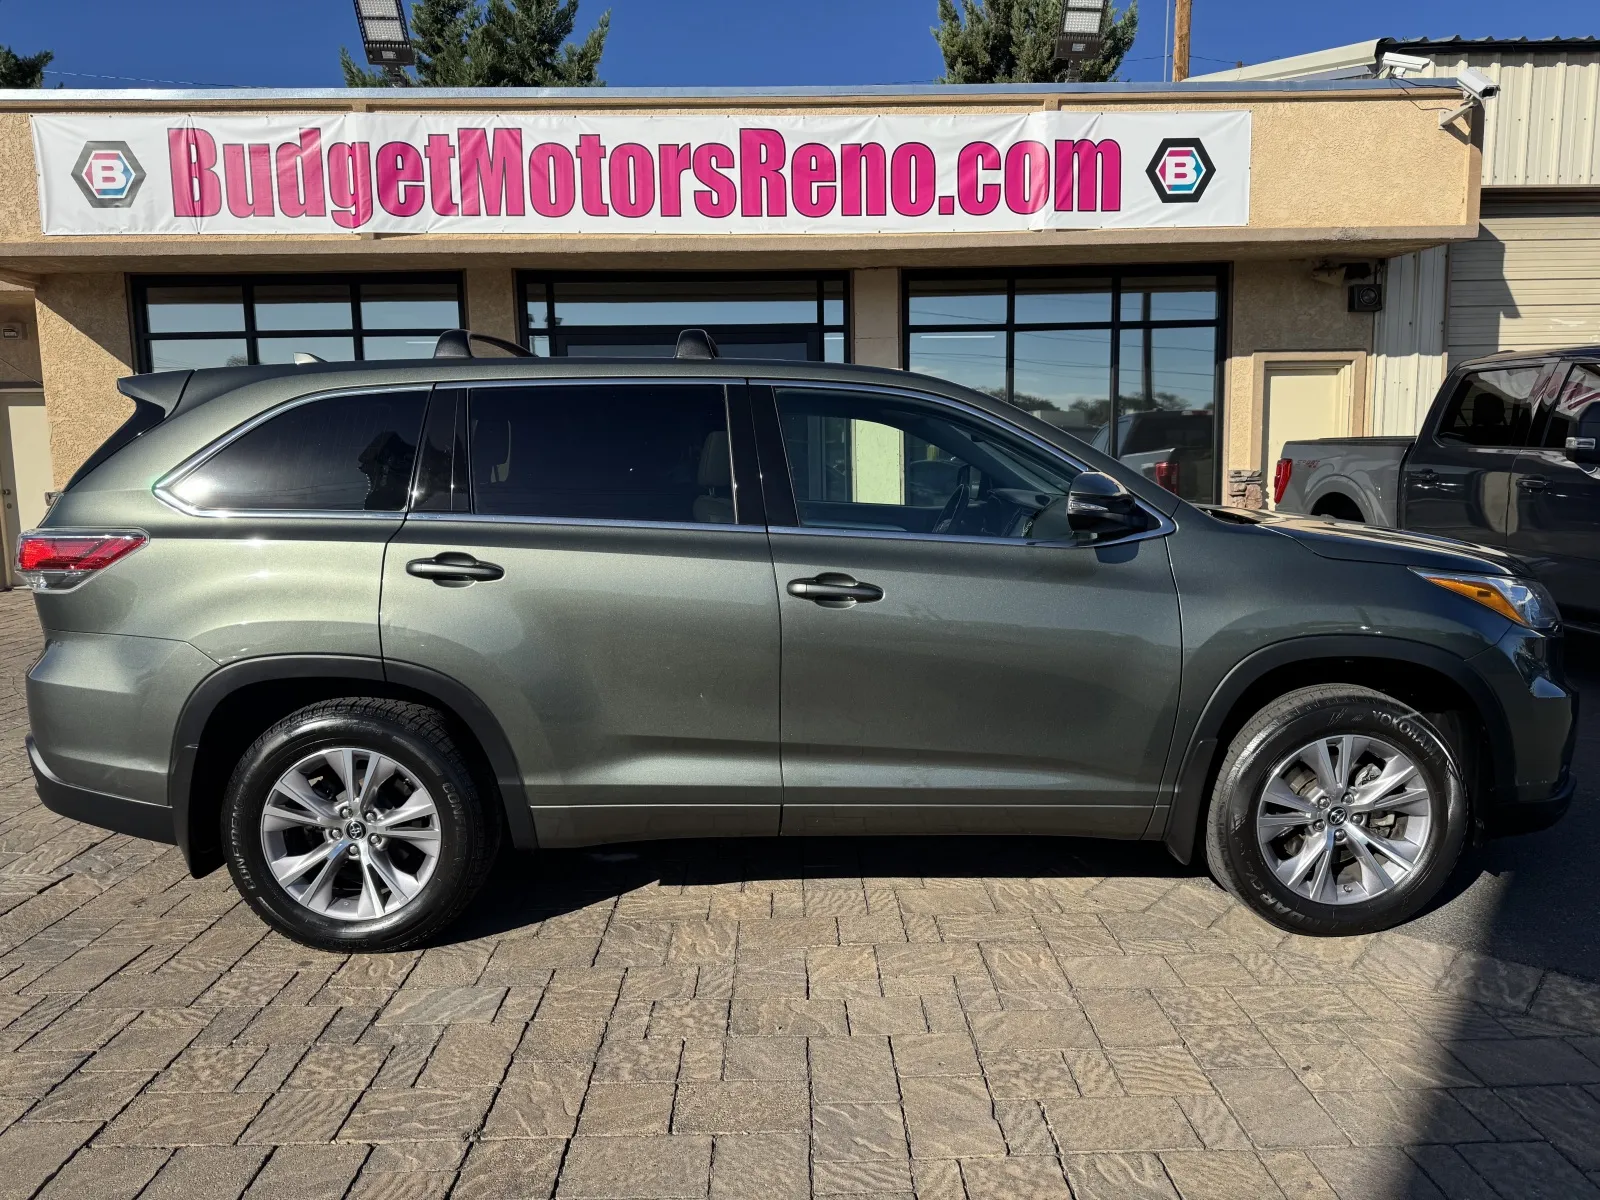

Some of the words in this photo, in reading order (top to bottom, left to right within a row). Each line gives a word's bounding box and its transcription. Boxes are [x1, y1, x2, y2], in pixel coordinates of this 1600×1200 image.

[92, 159, 126, 188] B
[167, 126, 1122, 229] BudgetMotorsReno.com
[1165, 156, 1198, 186] B
[441, 781, 468, 887] CONFIDEN
